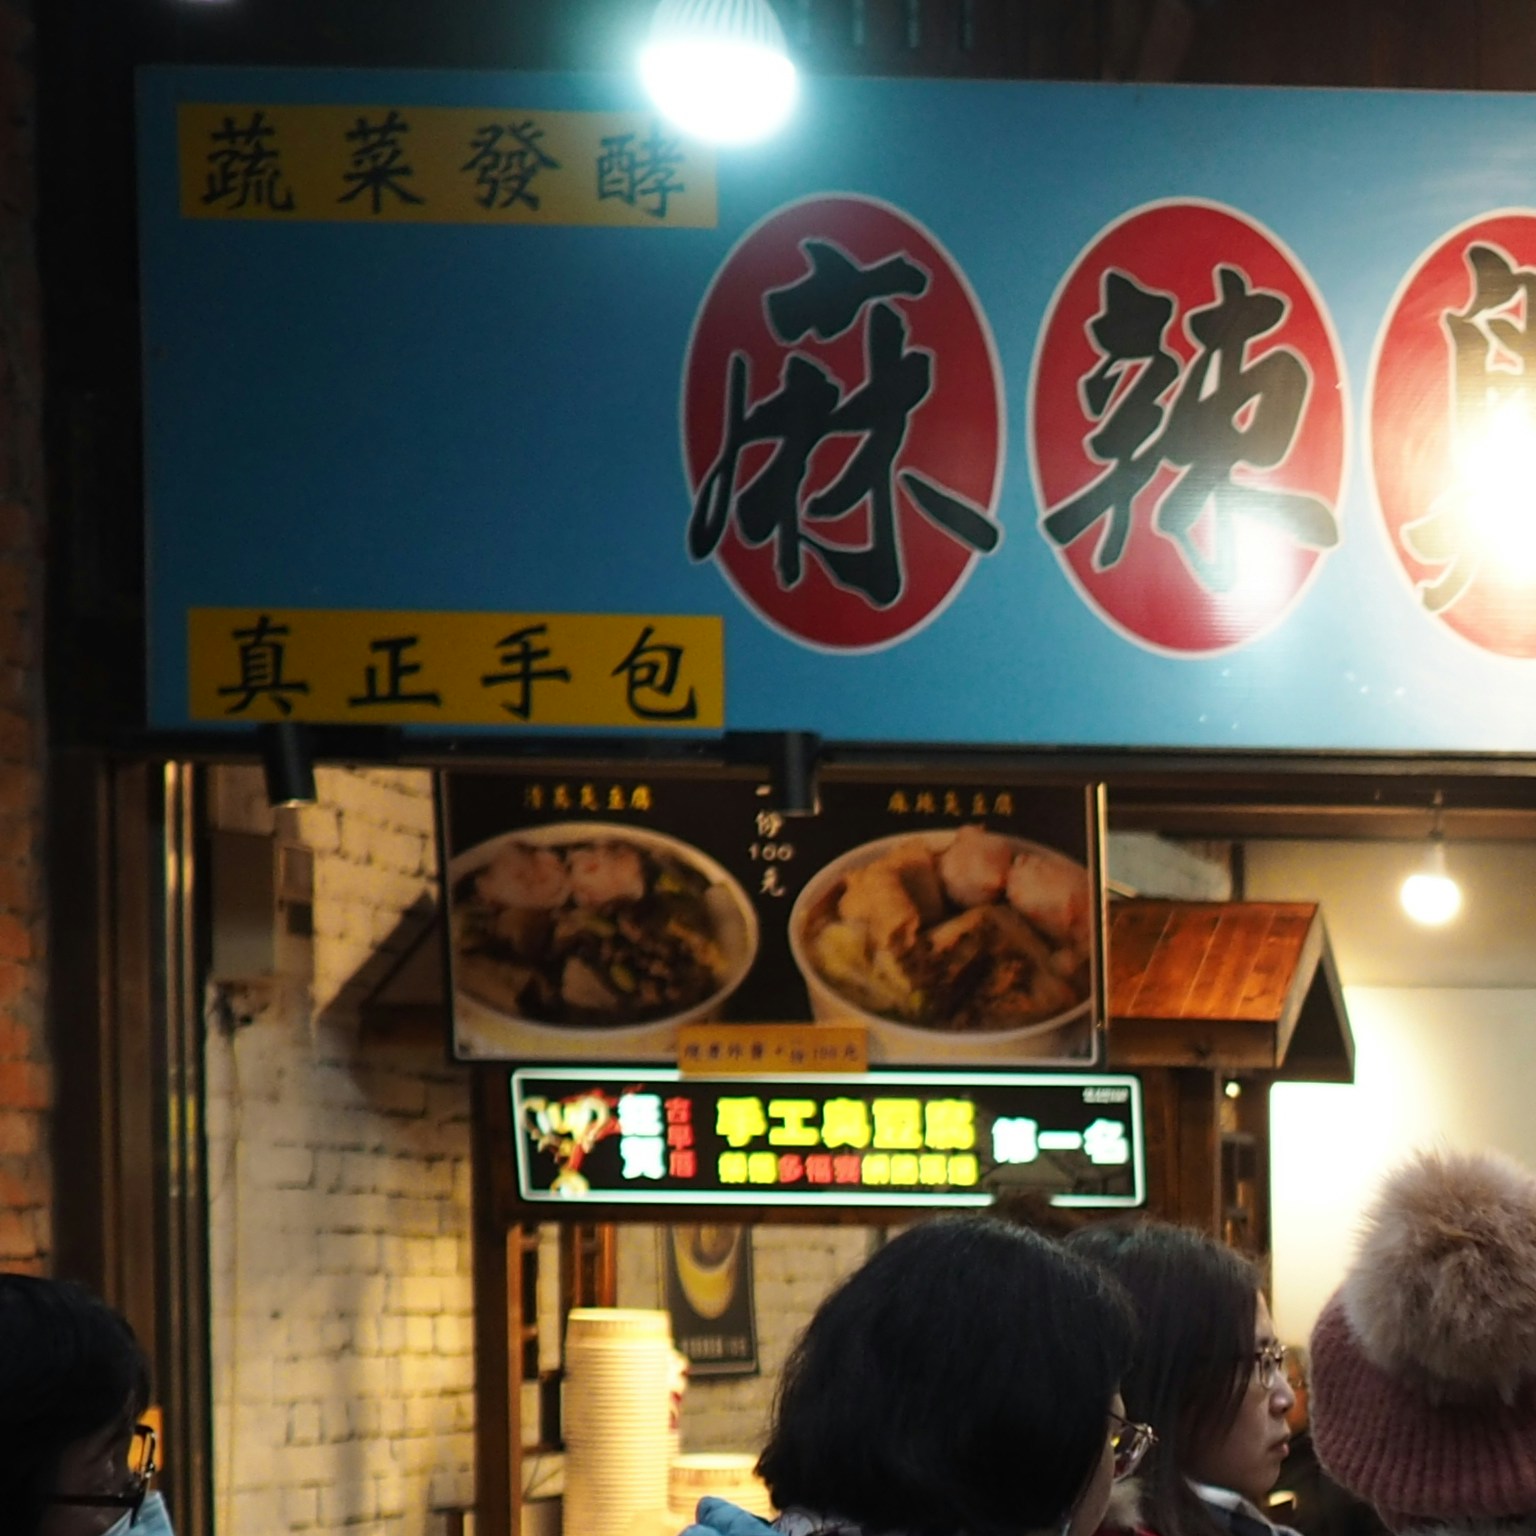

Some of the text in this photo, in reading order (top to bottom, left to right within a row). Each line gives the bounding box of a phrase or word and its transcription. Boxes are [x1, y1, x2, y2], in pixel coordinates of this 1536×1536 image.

[203, 112, 686, 218] 蔬菜發酵
[218, 614, 698, 722] 真正手包
